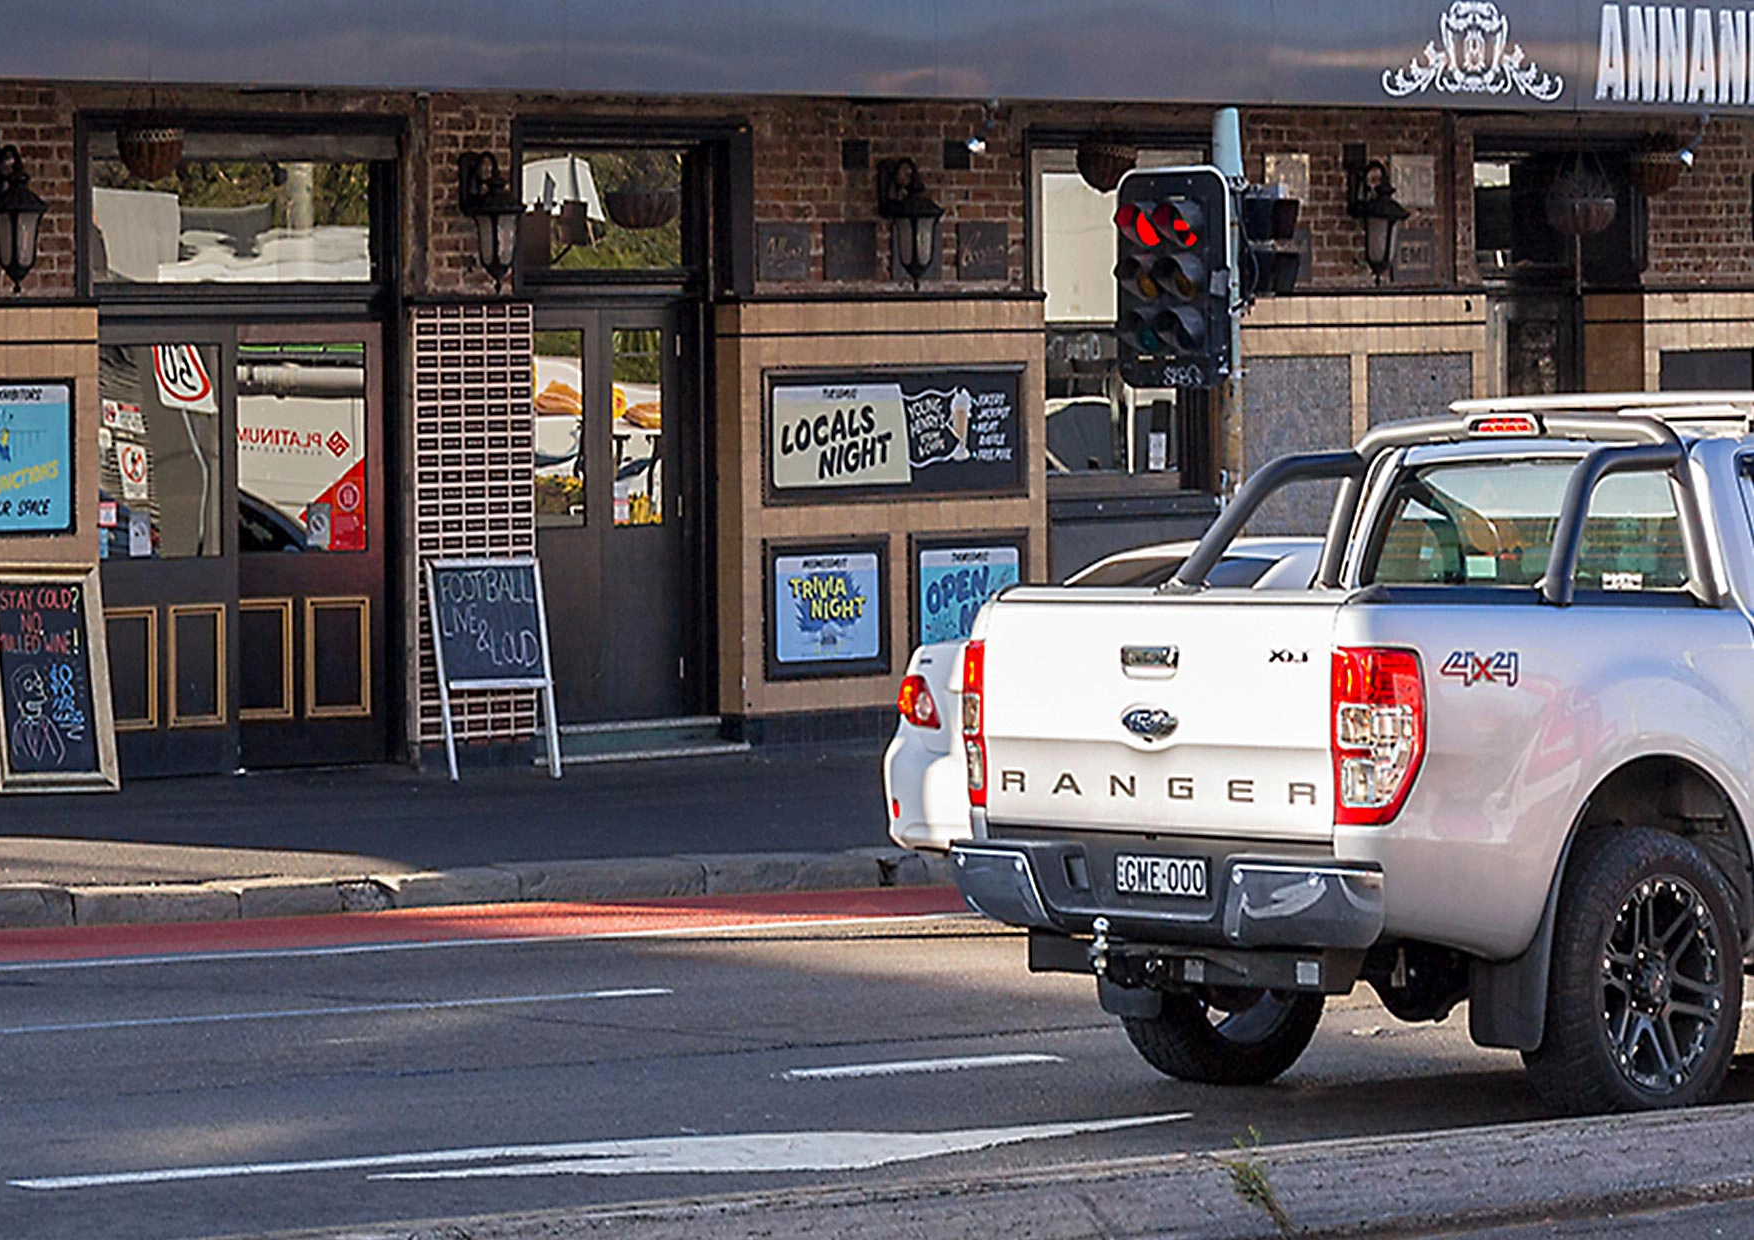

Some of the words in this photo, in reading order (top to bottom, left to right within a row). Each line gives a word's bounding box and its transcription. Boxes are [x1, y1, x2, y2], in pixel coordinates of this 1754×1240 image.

[1594, 3, 1754, 106] ANNAN
[781, 404, 877, 456] LOCALS
[818, 432, 892, 480] NIGHT
[17, 497, 52, 518] SPACE
[0, 589, 34, 611] STAY
[439, 568, 535, 603] FOOTBALL
[788, 575, 848, 600] TRIVIA
[926, 564, 990, 616] OPEN
[440, 604, 477, 636] LIVE
[810, 596, 867, 620] NIGHT
[489, 627, 541, 668] LOUD
[1000, 768, 1317, 806] RANGER
